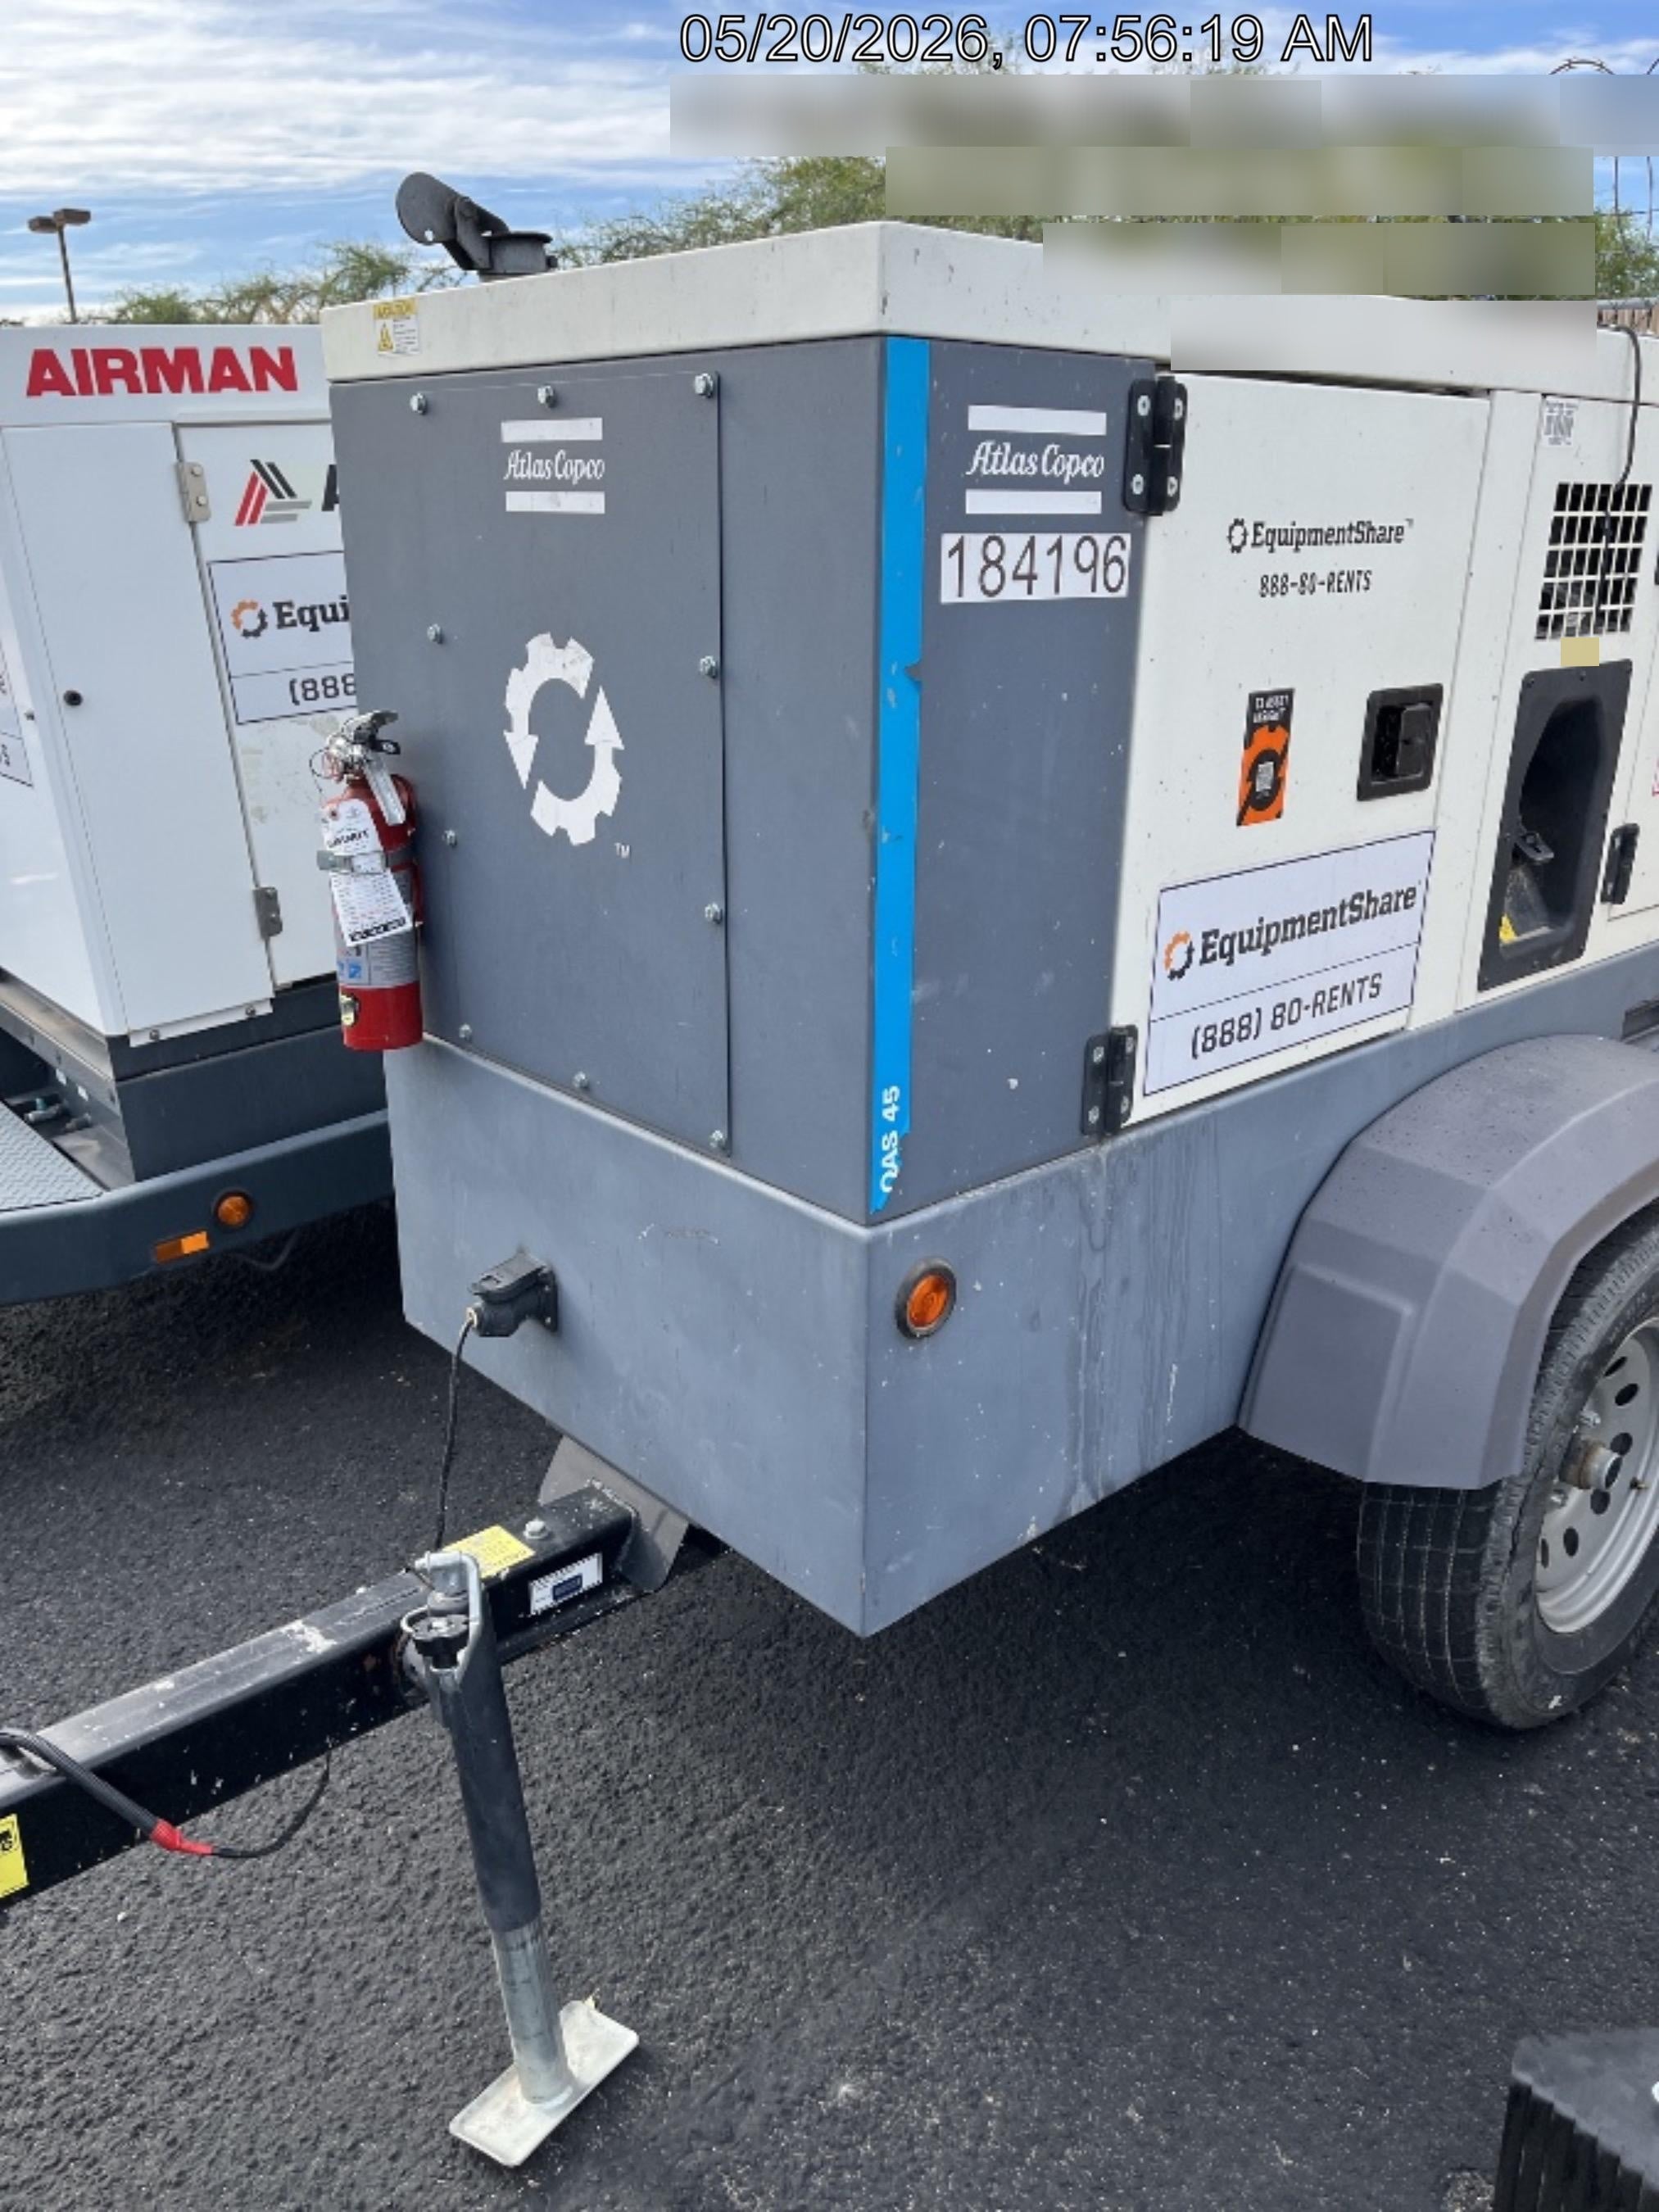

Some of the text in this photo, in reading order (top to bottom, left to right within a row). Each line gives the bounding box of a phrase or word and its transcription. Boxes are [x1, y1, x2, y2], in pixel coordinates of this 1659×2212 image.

[26, 347, 298, 397] AIRMAN
[503, 449, 605, 485] Atlas Copco
[965, 439, 1105, 485] Atlas Copco
[1250, 519, 1406, 554] EquipmentShare
[948, 534, 1126, 598] 184196
[1258, 569, 1373, 598] 888-80-RENTS
[1199, 886, 1417, 966] EquipmentShare
[1191, 972, 1383, 1060] (888) 80-RENTS
[882, 1086, 900, 1122] 45
